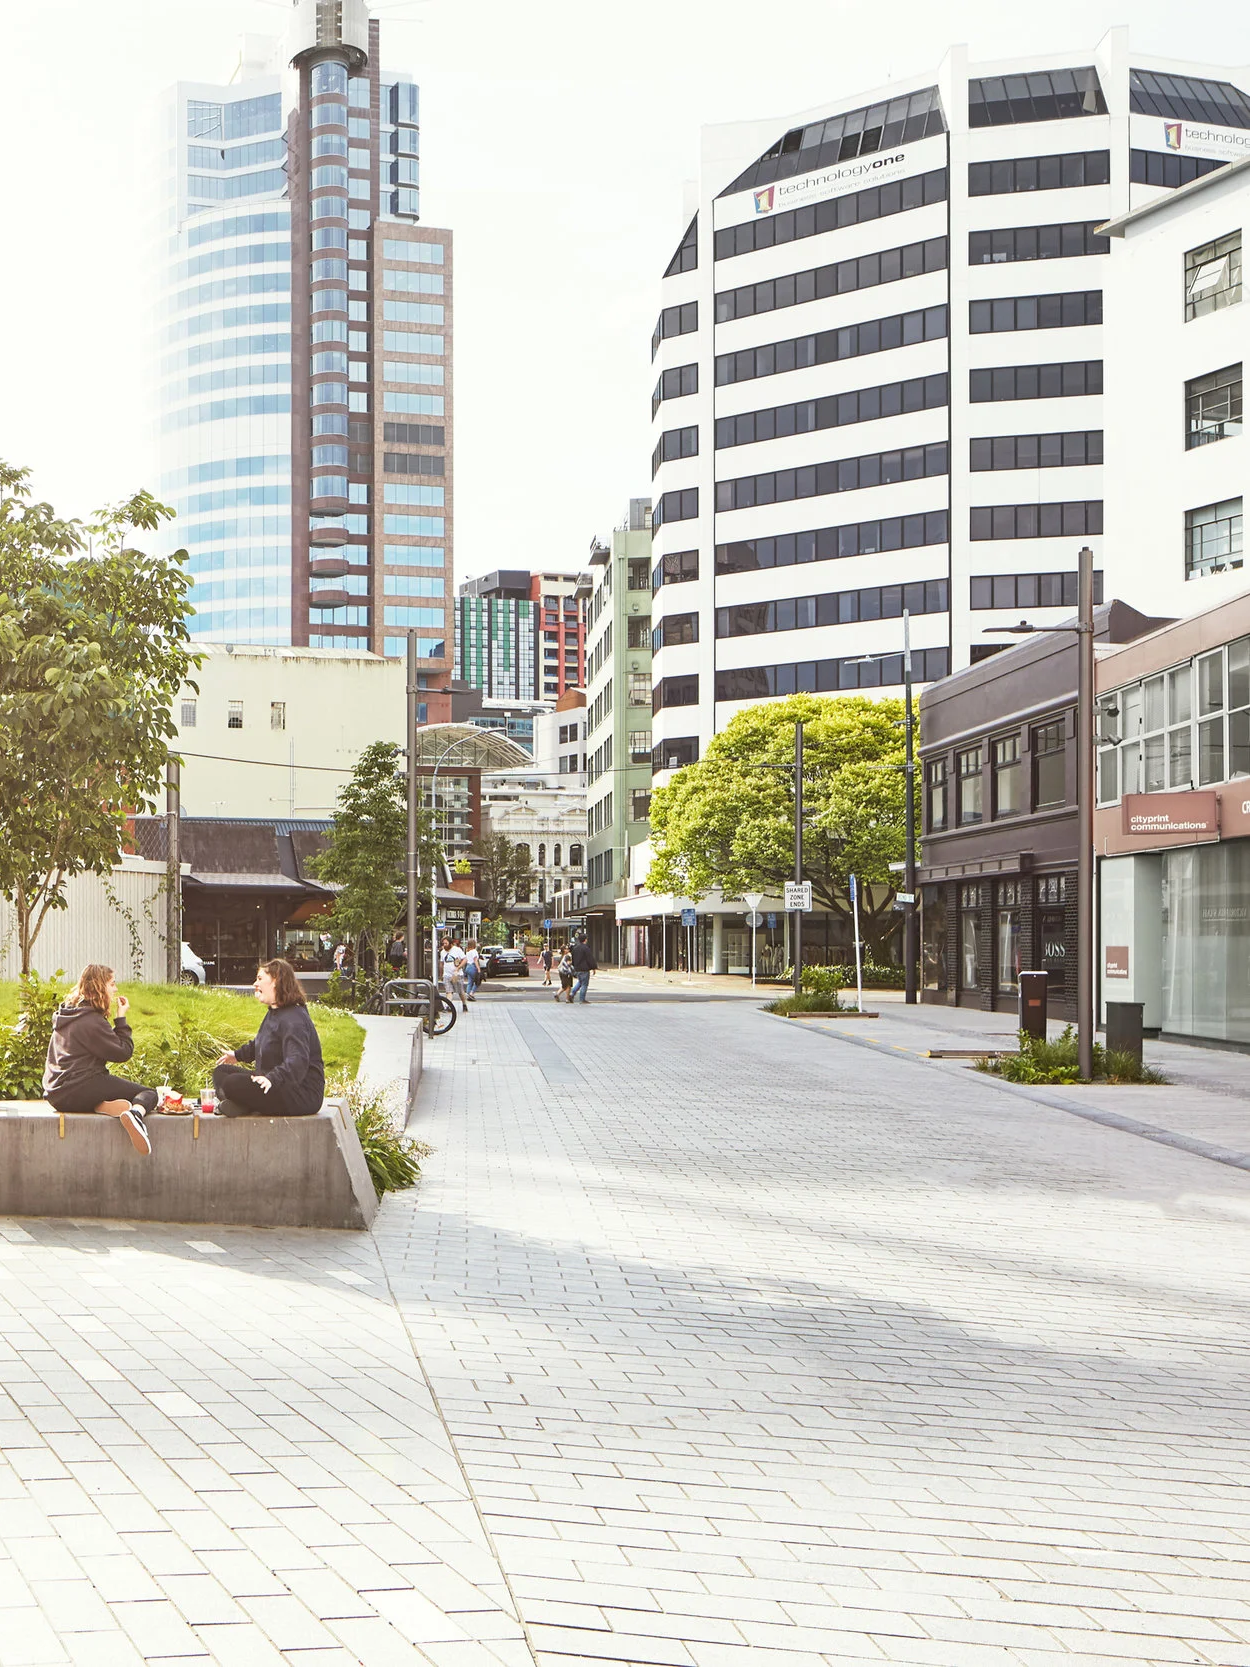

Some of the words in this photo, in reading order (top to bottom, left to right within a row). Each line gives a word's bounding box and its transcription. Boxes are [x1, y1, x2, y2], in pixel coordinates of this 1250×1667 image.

[779, 153, 905, 196] technologyone
[1130, 814, 1169, 824] cityprint
[1130, 822, 1207, 831] communications
